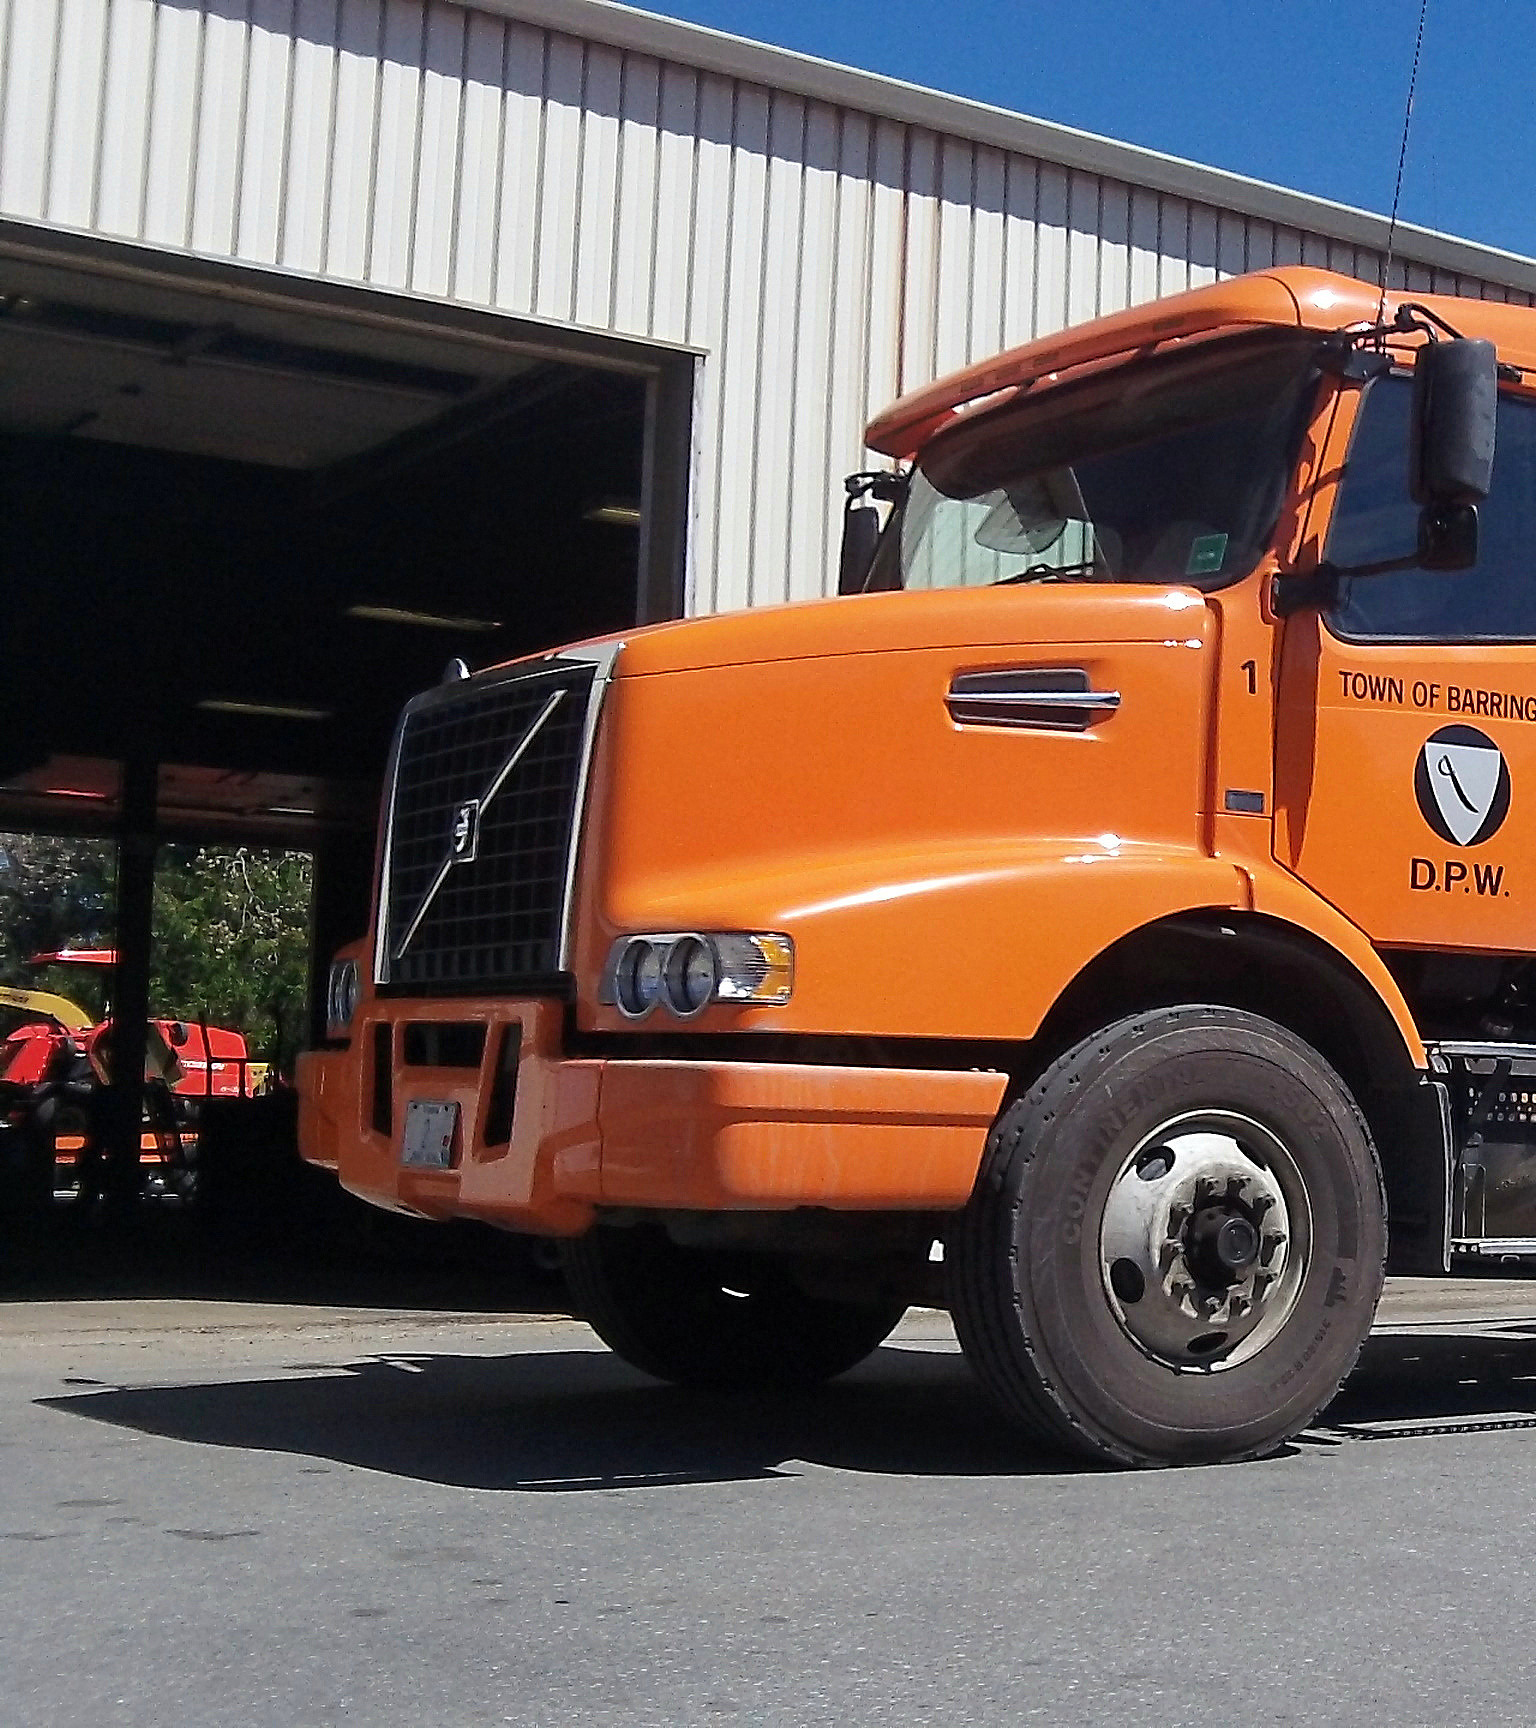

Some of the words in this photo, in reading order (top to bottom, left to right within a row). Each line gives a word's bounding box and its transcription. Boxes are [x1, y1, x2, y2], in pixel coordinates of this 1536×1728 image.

[1240, 659, 1257, 695] 1
[1338, 670, 1404, 704] TOWN
[1412, 681, 1441, 708] OF
[1410, 857, 1511, 898] D.P.W.
